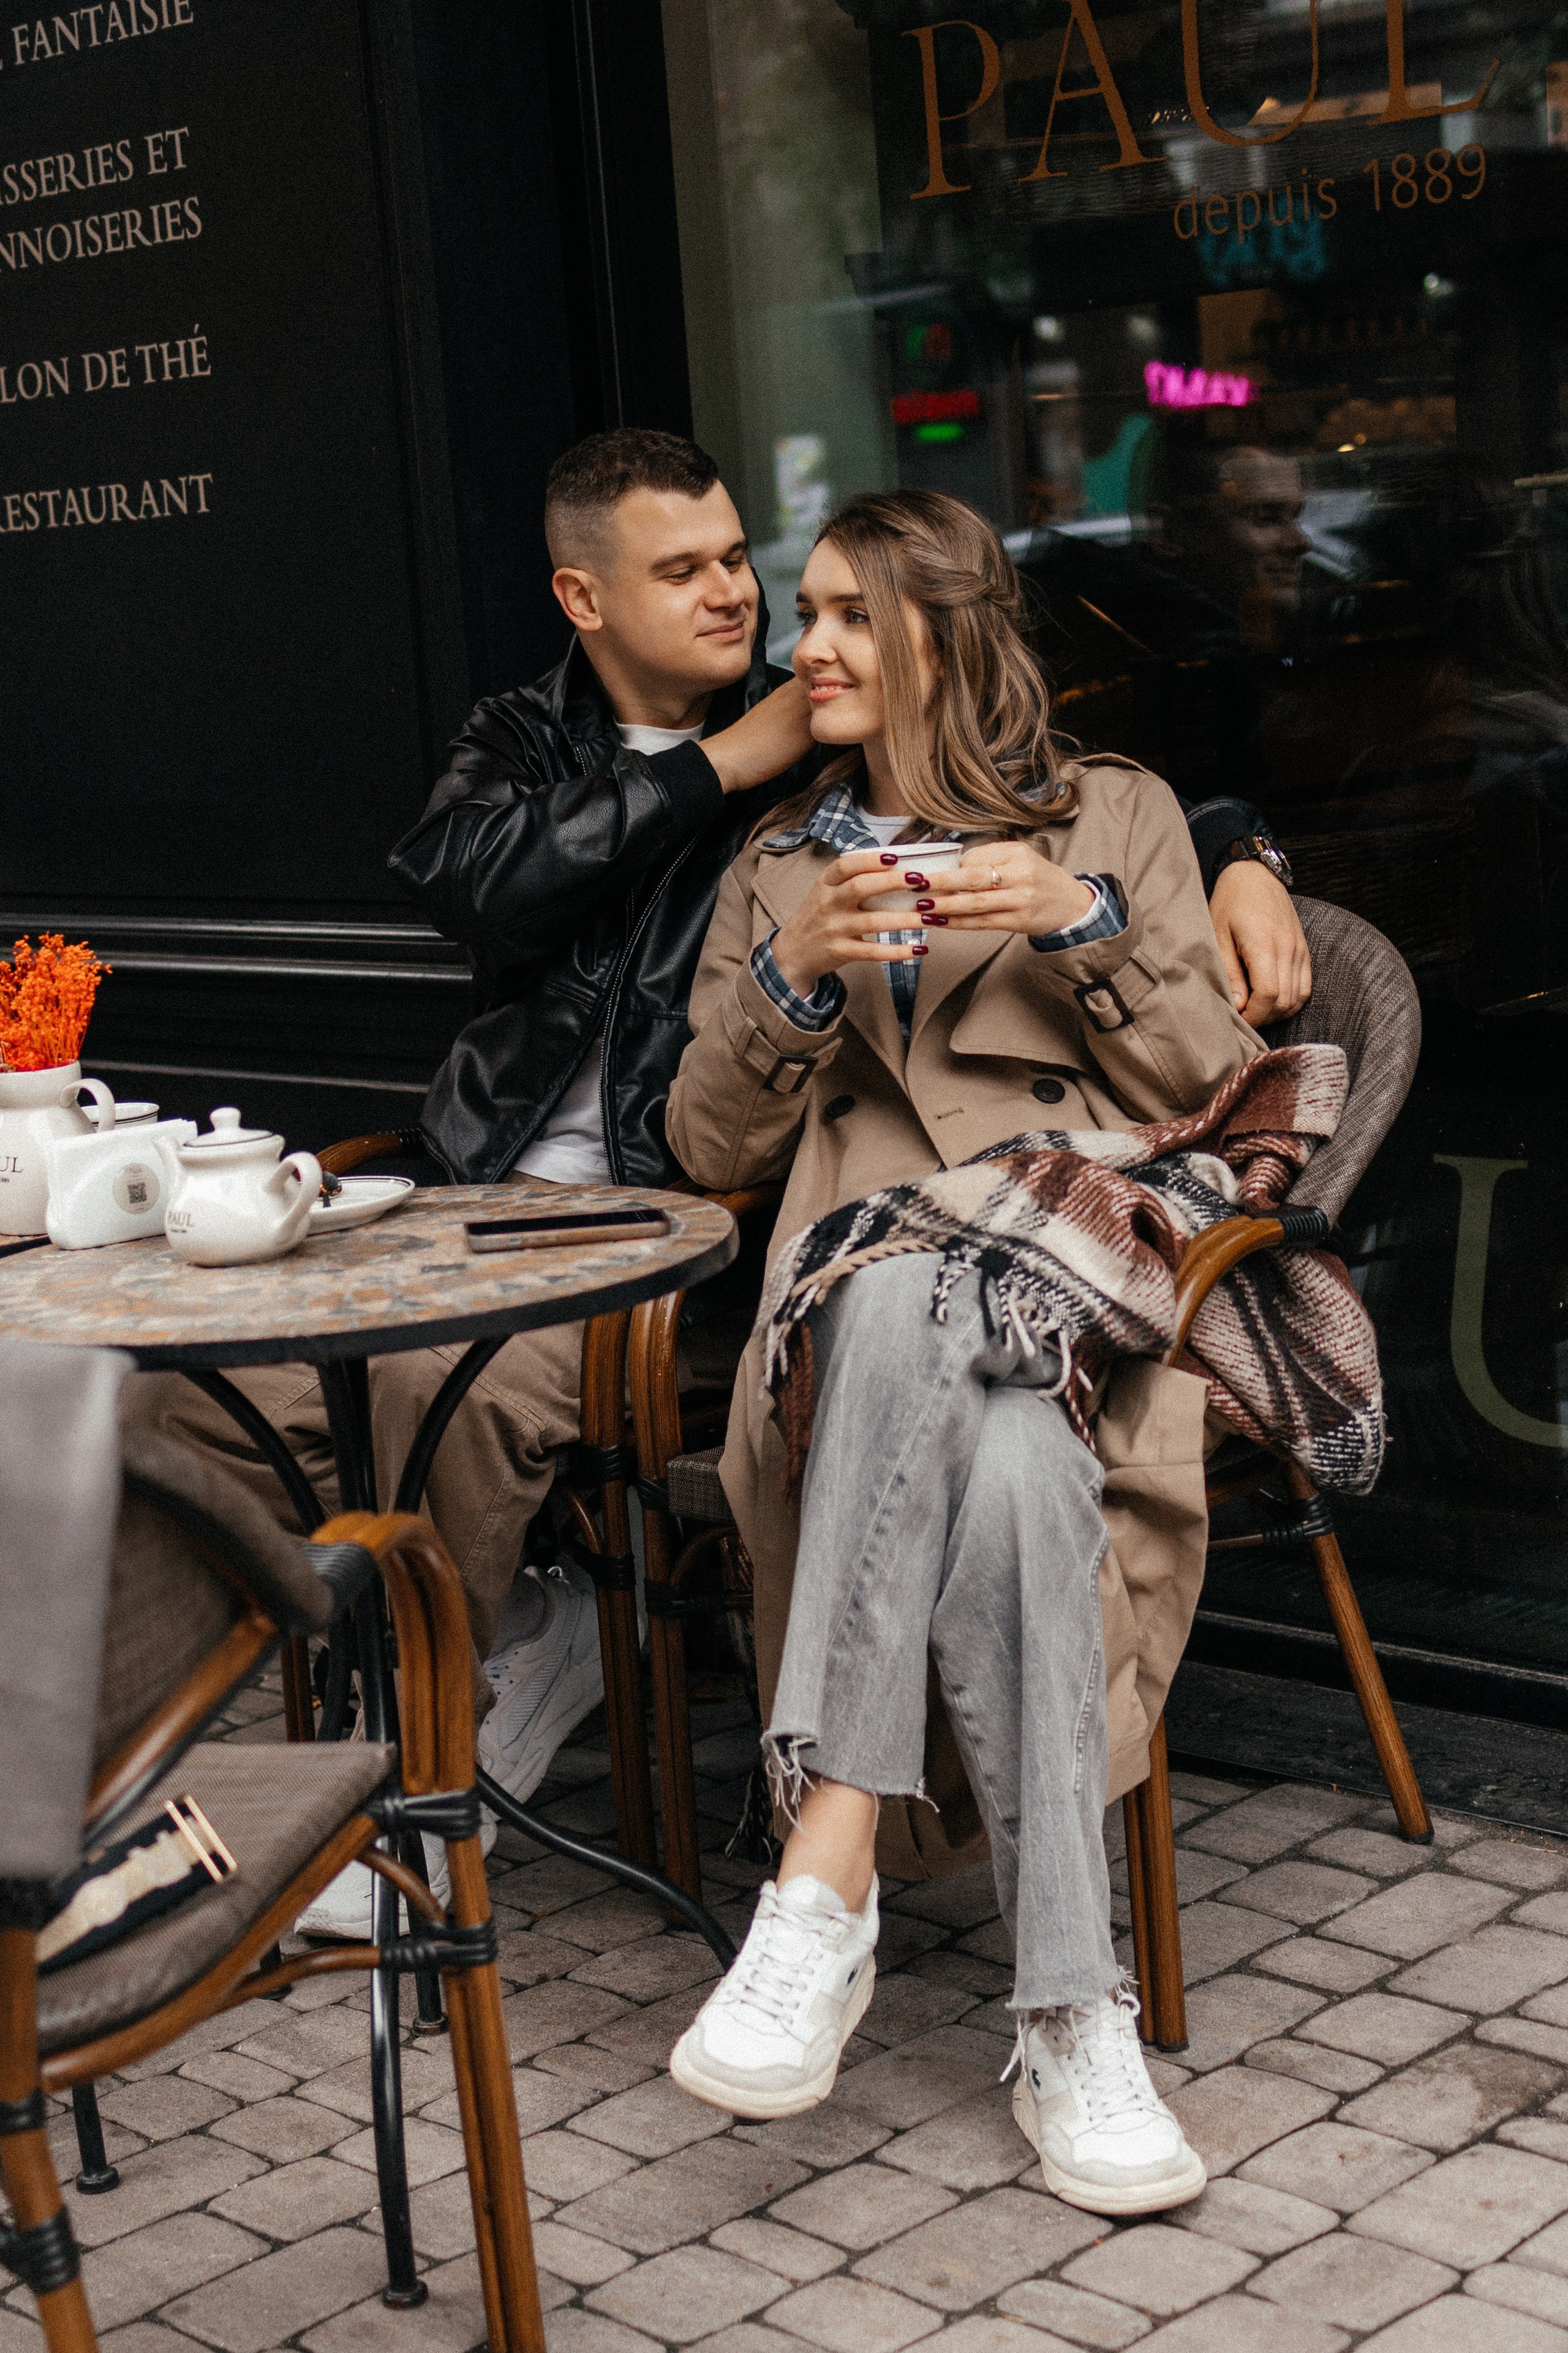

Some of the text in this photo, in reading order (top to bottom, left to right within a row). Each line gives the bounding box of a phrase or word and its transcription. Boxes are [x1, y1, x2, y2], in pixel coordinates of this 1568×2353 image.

[11, 0, 194, 65] FANTAISIE
[902, 0, 1500, 200] PAUL
[0, 126, 189, 206] SSERIES ET
[1173, 143, 1487, 244] depuis 1889
[81, 348, 130, 392] DE
[135, 323, 211, 384] THÉ
[0, 473, 213, 533] ESTAURANT
